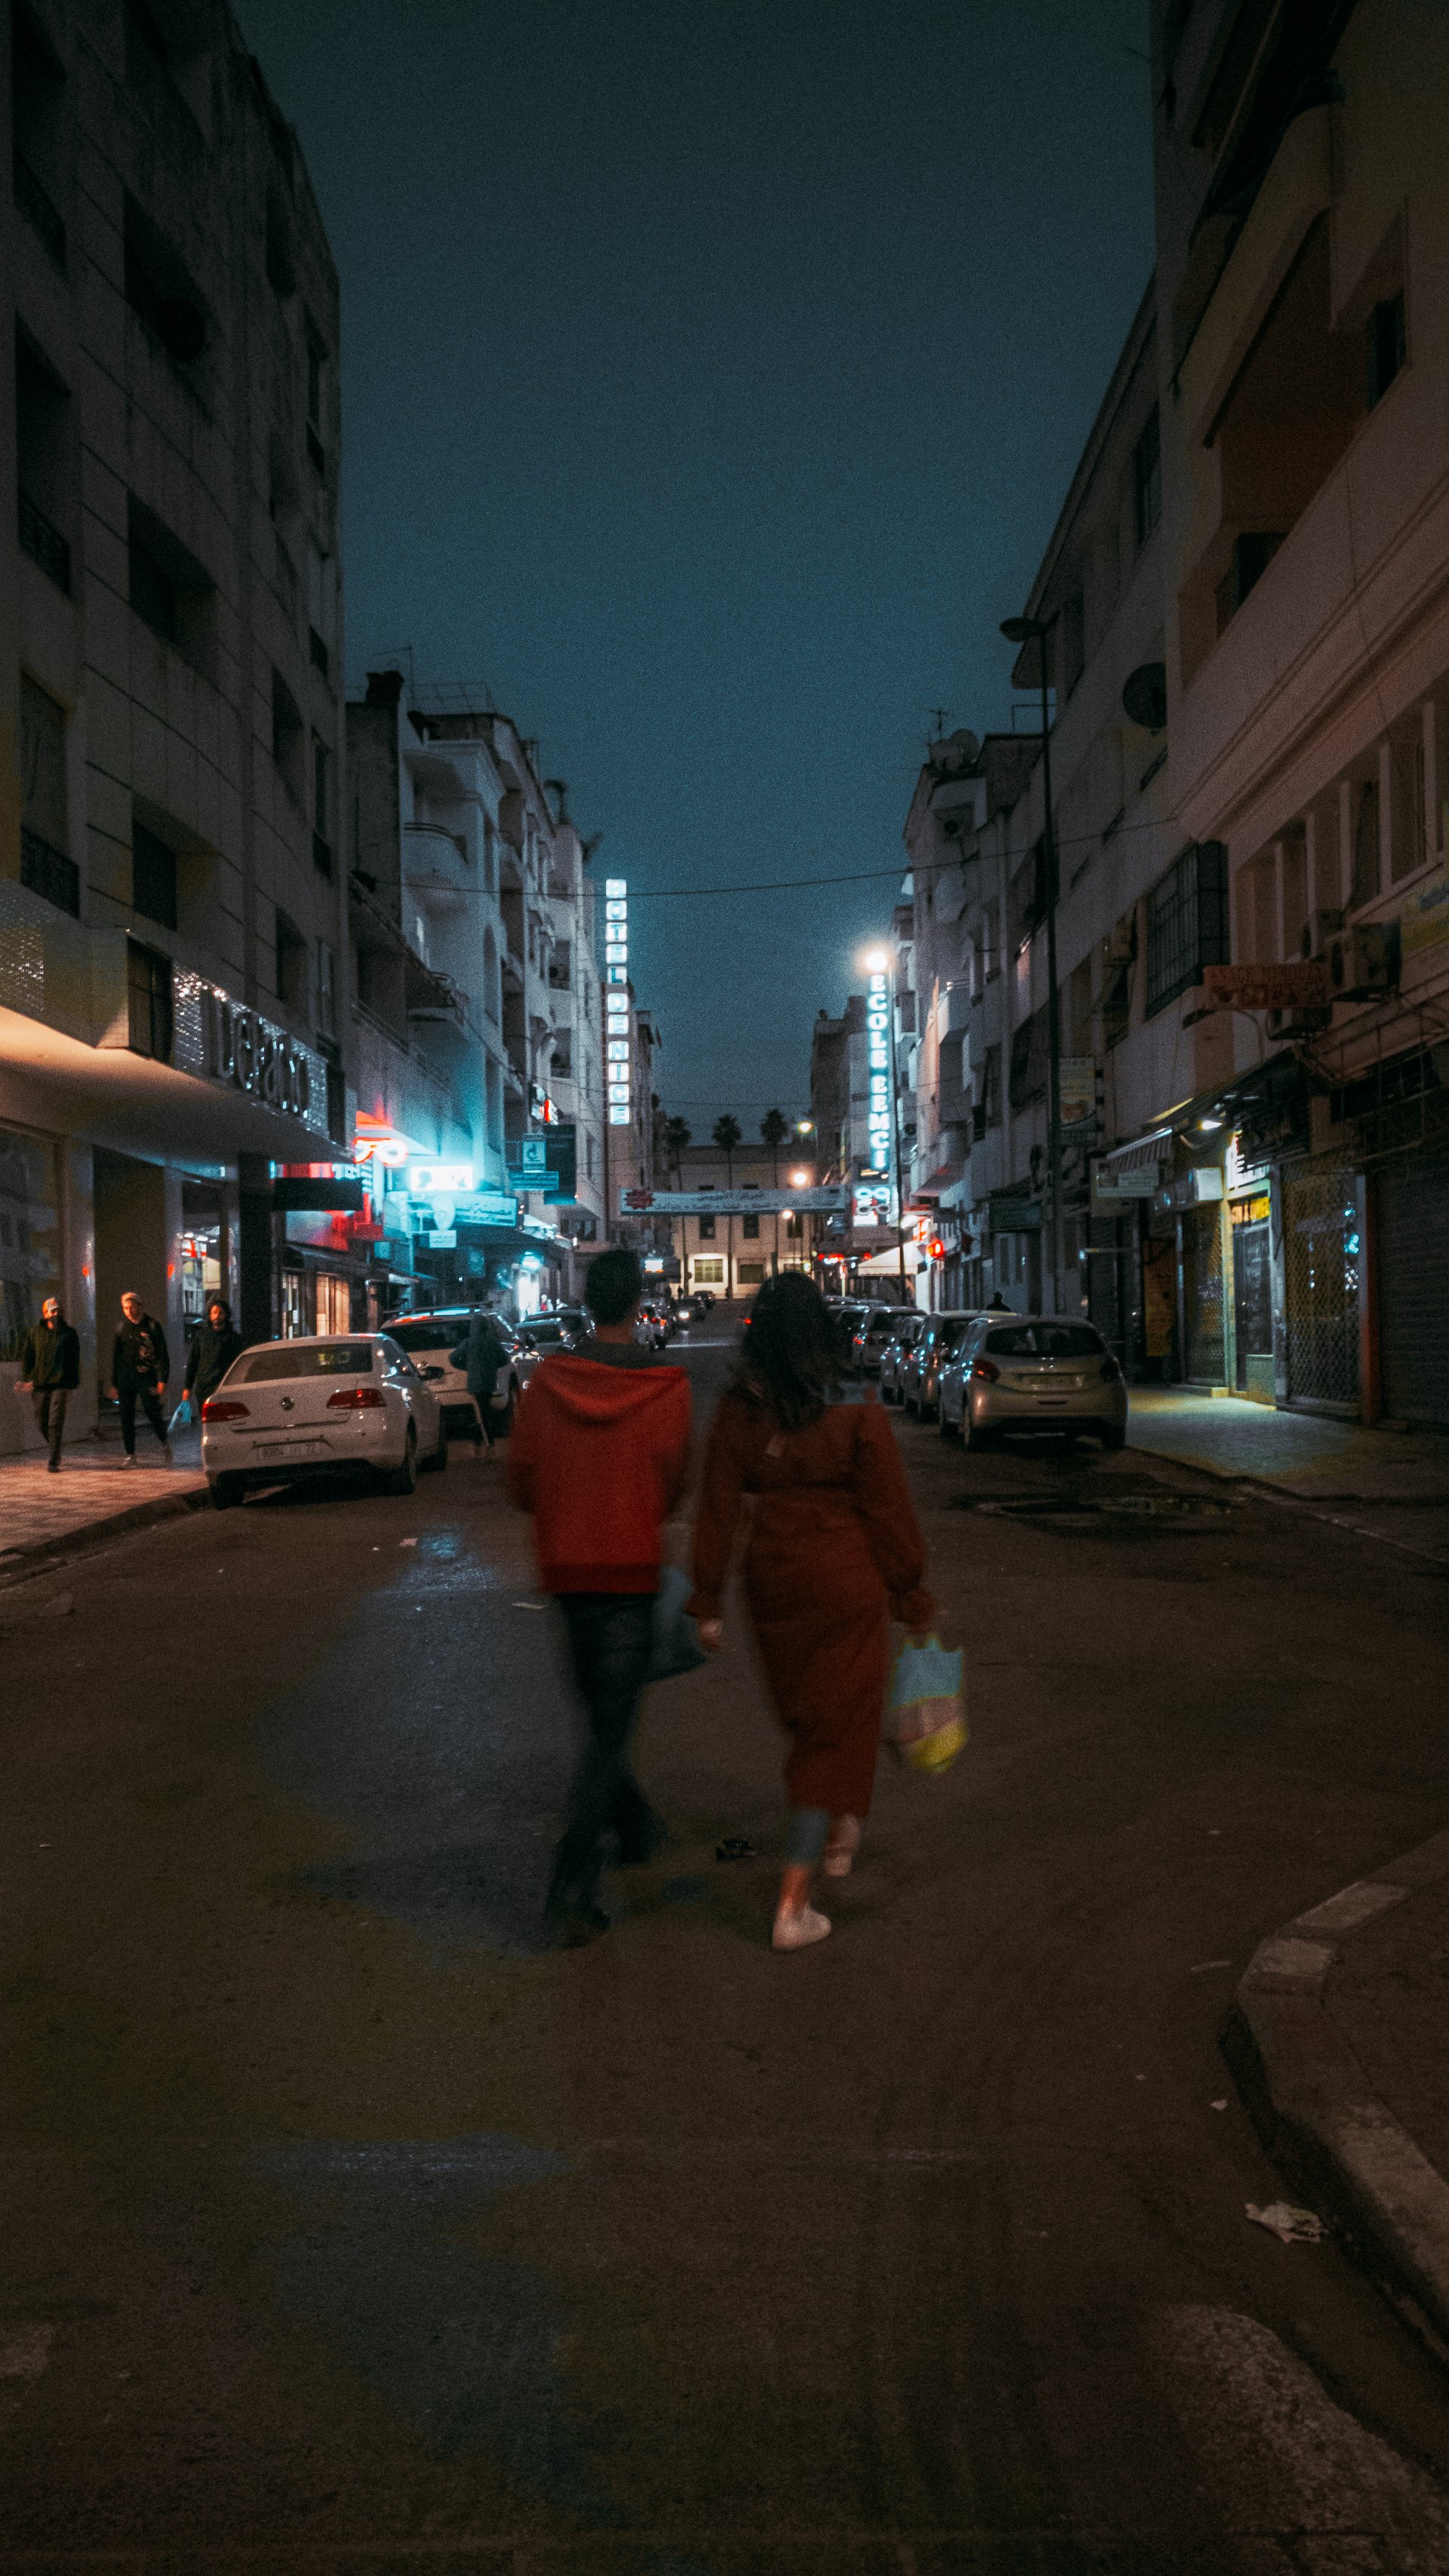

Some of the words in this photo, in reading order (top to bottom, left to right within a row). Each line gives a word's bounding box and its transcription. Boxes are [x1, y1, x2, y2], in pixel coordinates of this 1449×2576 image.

[607, 879, 627, 983] HOTEL
[608, 993, 629, 1034] DE
[869, 974, 888, 1068] ECOLE
[608, 1042, 629, 1125] NICE
[869, 1076, 890, 1168] EEMCI
